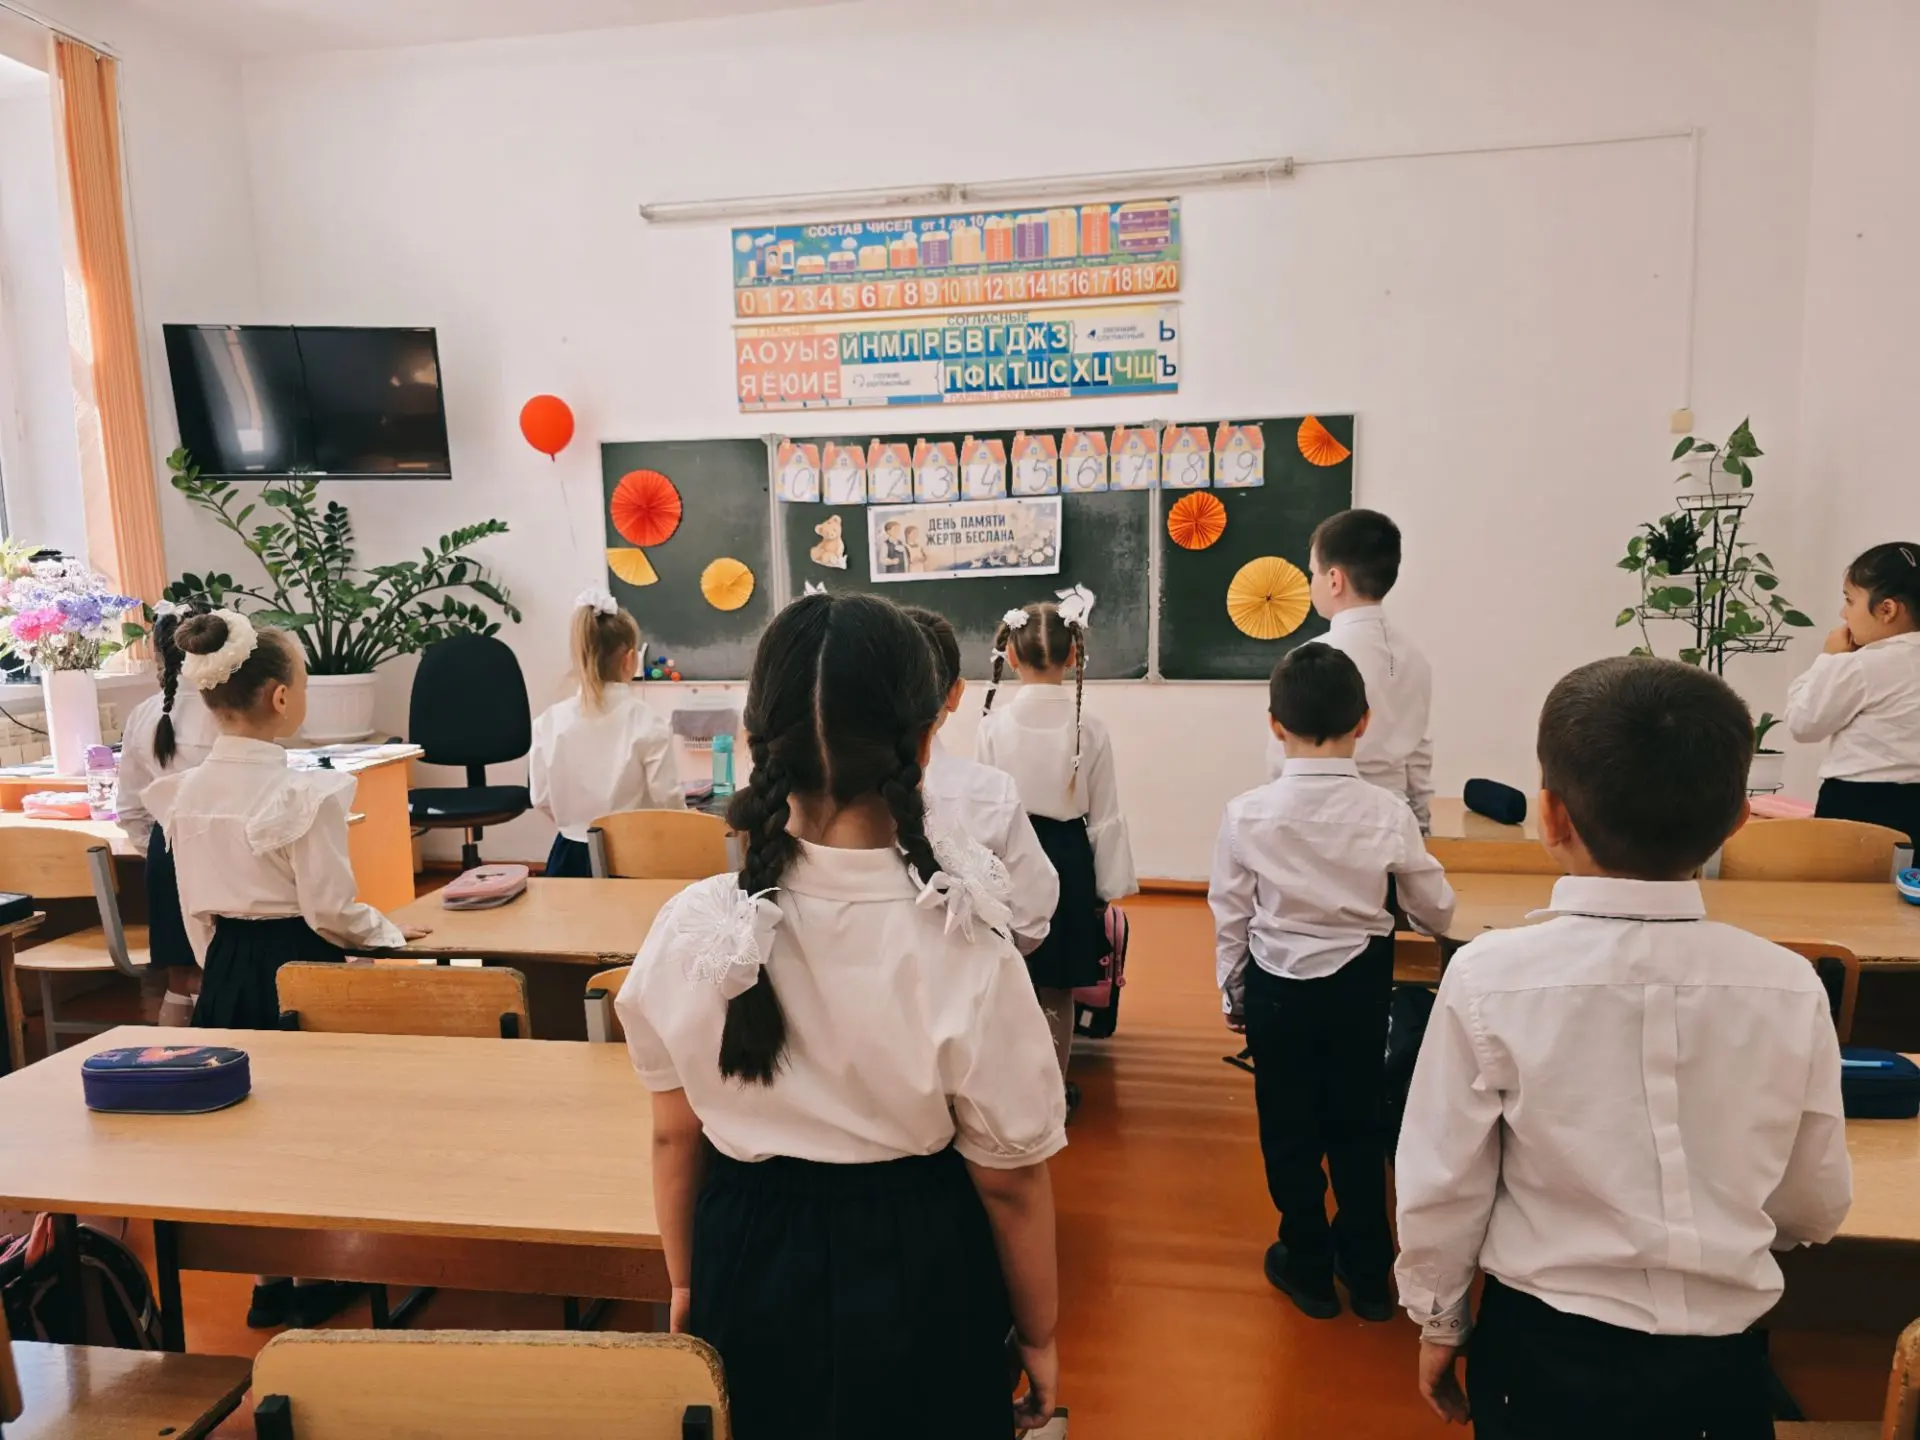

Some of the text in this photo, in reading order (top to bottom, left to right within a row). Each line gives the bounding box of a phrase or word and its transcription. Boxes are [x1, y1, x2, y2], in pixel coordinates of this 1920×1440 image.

[808, 223, 862, 238] СОСТАВ
[866, 219, 912, 233] ЧИСЕЛ
[939, 218, 946, 231] 1
[970, 214, 984, 229] 10
[742, 264, 1176, 314] 0 1 2 3 4 5 6 7 8 9 10 11 12 13 14 15 16 17 18 19 20
[947, 312, 1028, 326] СОГЛАСНЫЕ
[792, 451, 1257, 501] 0 1 2 3 4 5 6 7 8 9
[928, 515, 1005, 531] ДЕНЬ ПАМЯТИ
[926, 530, 1015, 546] ЖЕРТВ БЕСЛАНА
